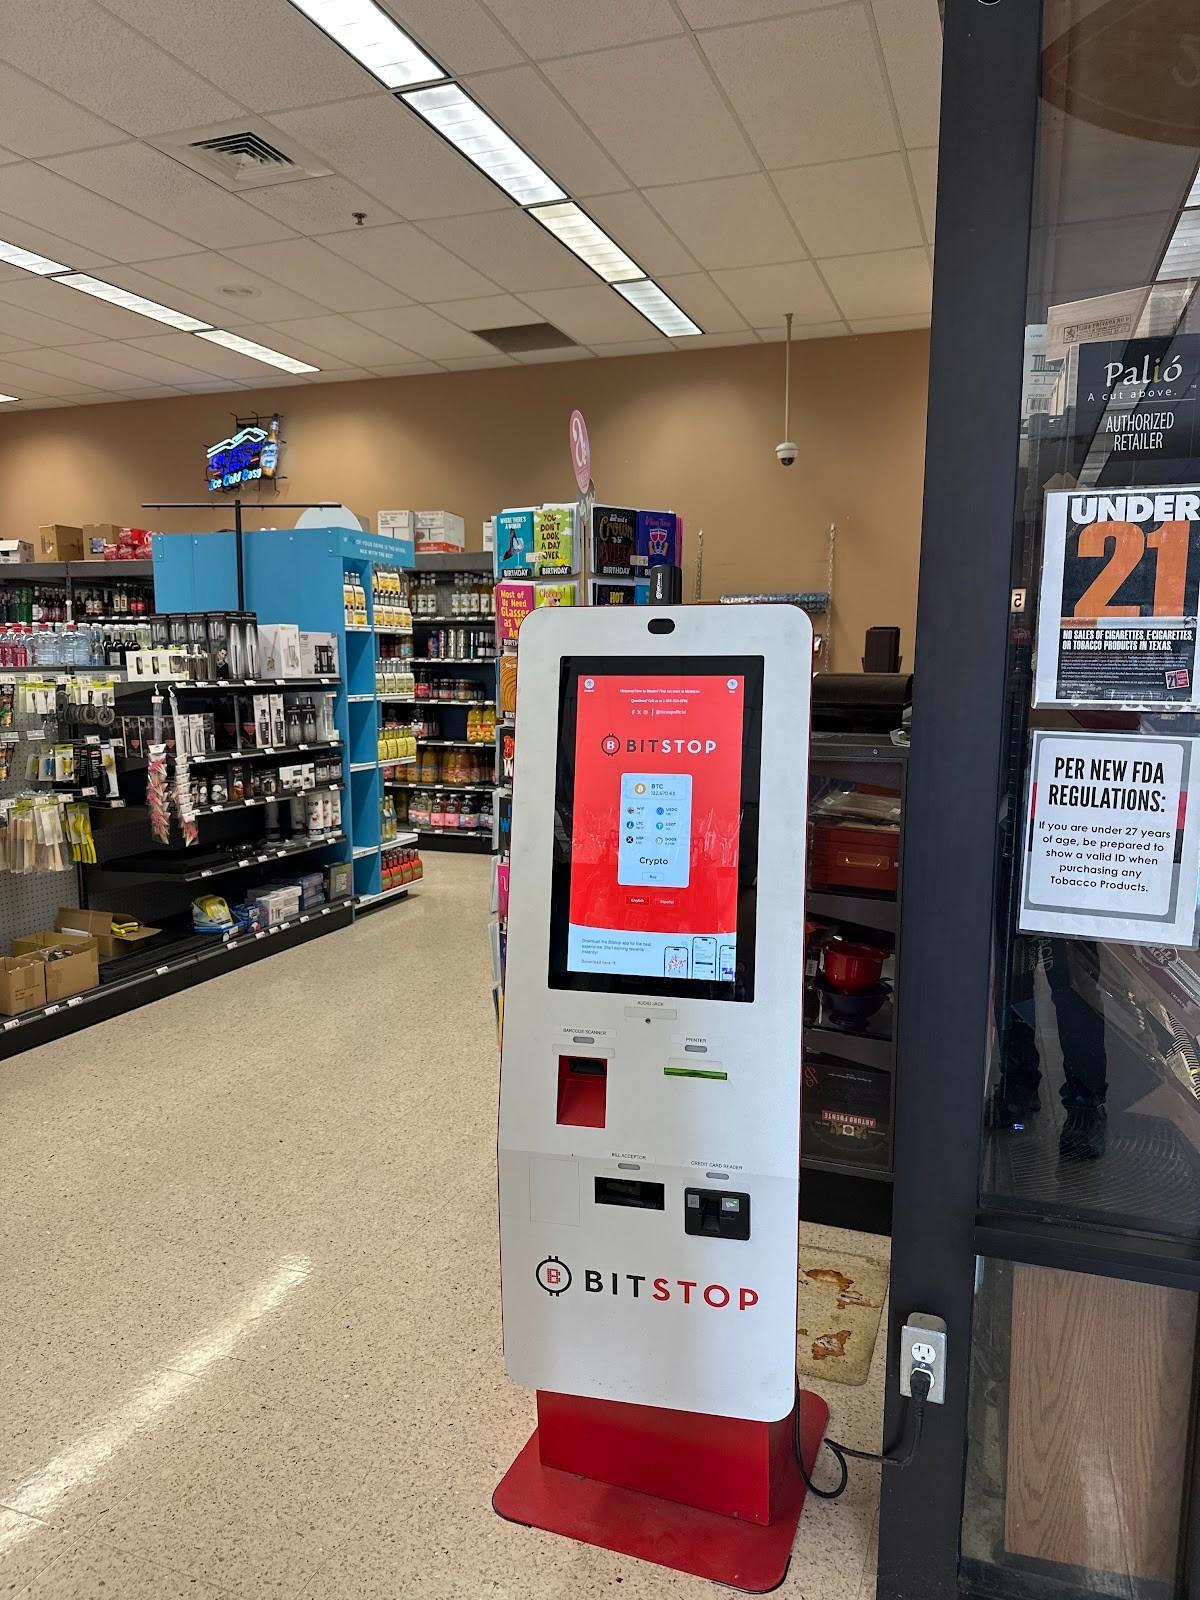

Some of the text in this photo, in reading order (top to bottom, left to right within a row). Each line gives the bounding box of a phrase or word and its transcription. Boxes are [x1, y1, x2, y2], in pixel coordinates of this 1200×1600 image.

[1104, 354, 1183, 388] Palió
[1088, 388, 1177, 402] A cut above.
[1106, 411, 1174, 433] AUTHORIZED
[1114, 432, 1163, 451] RETAILER
[223, 471, 242, 486] Cold
[1071, 494, 1200, 524] UNDER
[543, 514, 557, 522] YOU
[540, 523, 561, 532] DON'T
[542, 532, 560, 540] LOOK
[547, 542, 561, 550] DAY
[503, 569, 529, 577] BIRTHDAY
[542, 567, 569, 575] BIRTHDAY
[602, 566, 630, 575] BIRTHDAY
[1073, 521, 1191, 618] 21
[501, 590, 525, 599] Most of
[609, 591, 624, 604] HOT
[511, 600, 527, 608] Need
[1062, 630, 1072, 639] NO
[1074, 630, 1094, 640] SALES
[1096, 631, 1104, 640] OF
[1062, 641, 1072, 650] OR
[1073, 641, 1102, 650] TOBACCO
[1104, 641, 1138, 650] PRODUCTS
[1140, 641, 1148, 650] IN
[626, 739, 716, 754] BITSTOP
[1054, 757, 1165, 784] PER NEW FDA
[1048, 784, 1166, 813] REGULATIONS:
[1039, 821, 1171, 839] If you are under 27 years
[1056, 838, 1079, 846] age,
[1083, 838, 1097, 846] be
[1100, 840, 1150, 851] prepared
[1154, 843, 1164, 852] to
[639, 857, 668, 865] Crypto
[1046, 849, 1072, 858] show
[1086, 852, 1112, 861] valid
[1115, 853, 1126, 862] ID
[1128, 855, 1158, 865] when
[1059, 864, 1142, 878] purchasing any
[1050, 876, 1149, 892] Tobacco Products.
[691, 1160, 708, 1168] CREDIT
[584, 1269, 759, 1311] BITSTOP
